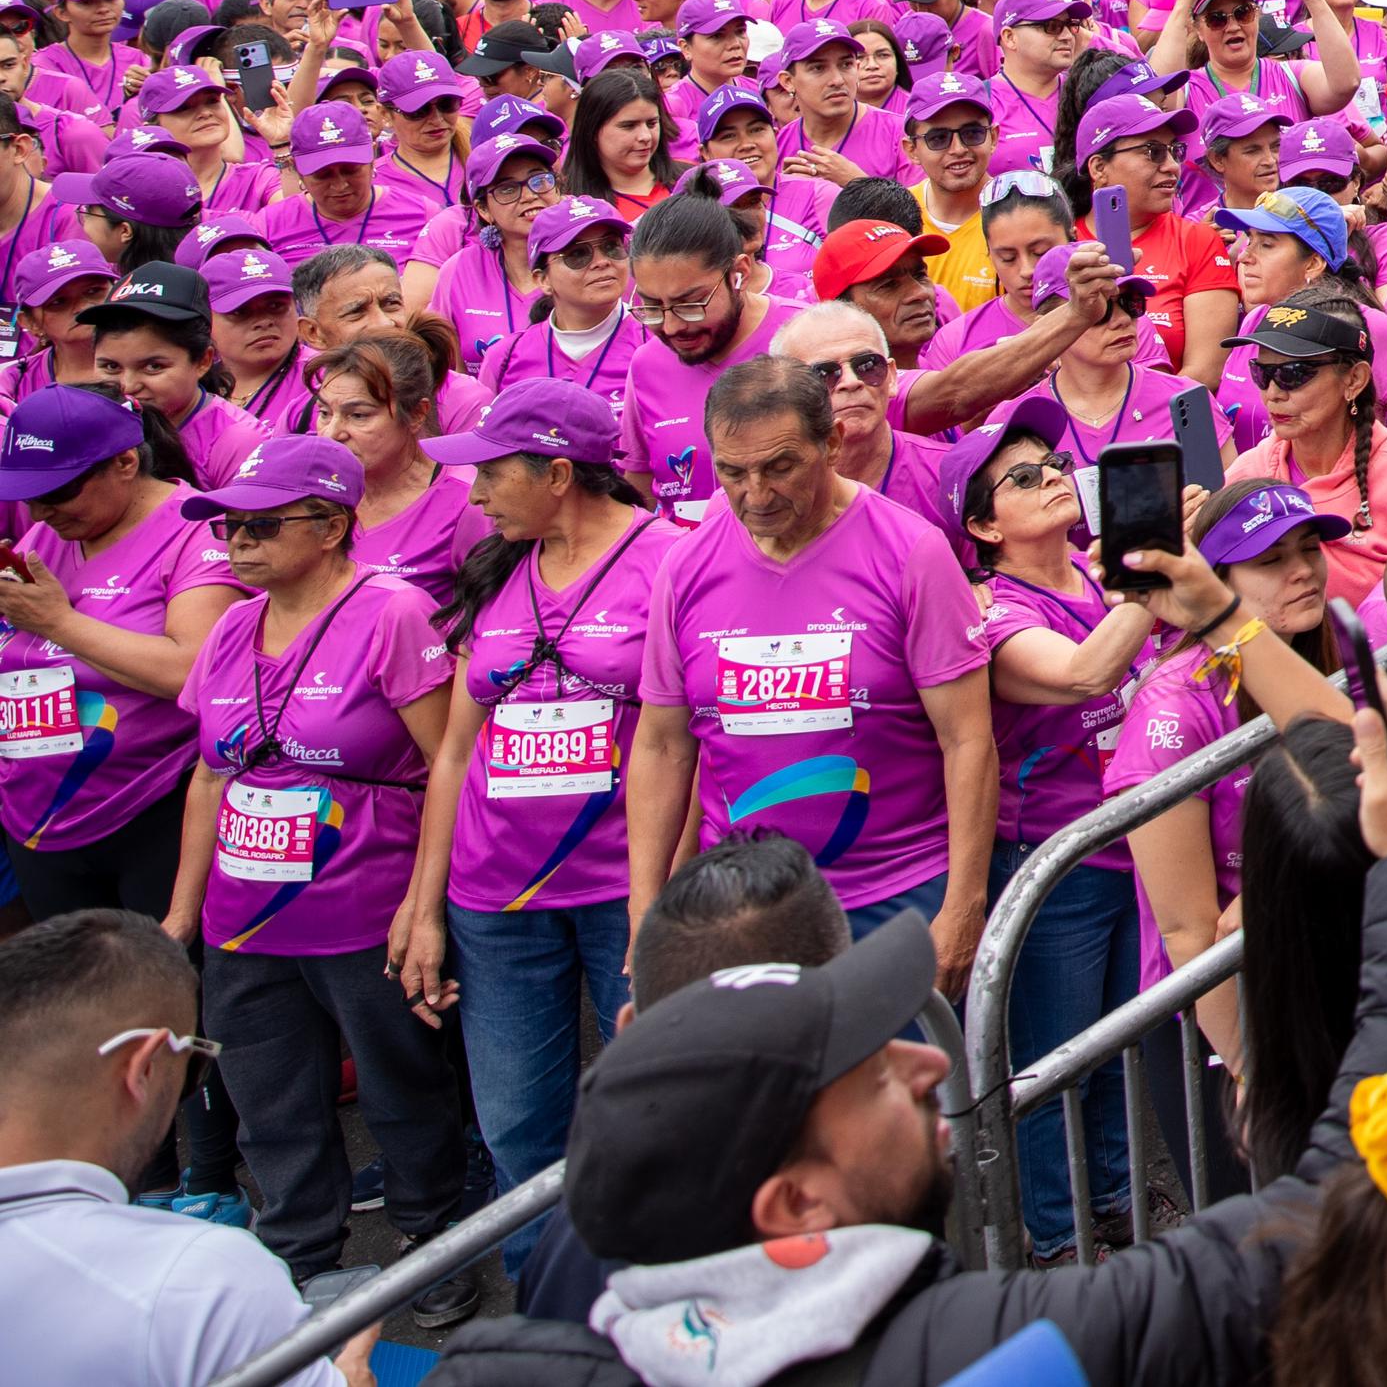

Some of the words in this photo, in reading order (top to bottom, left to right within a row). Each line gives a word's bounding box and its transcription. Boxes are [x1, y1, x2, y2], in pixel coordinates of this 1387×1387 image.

[699, 628, 750, 639] SPORTLINE
[742, 666, 824, 701] 28277
[0, 696, 54, 730] 30111
[766, 701, 800, 710] HECTOR
[1081, 703, 1117, 720] Carrera
[507, 731, 587, 765] 30389
[519, 765, 568, 775] ESMERALDA
[227, 812, 291, 850] 30388
[251, 851, 286, 861] ROSARIO
